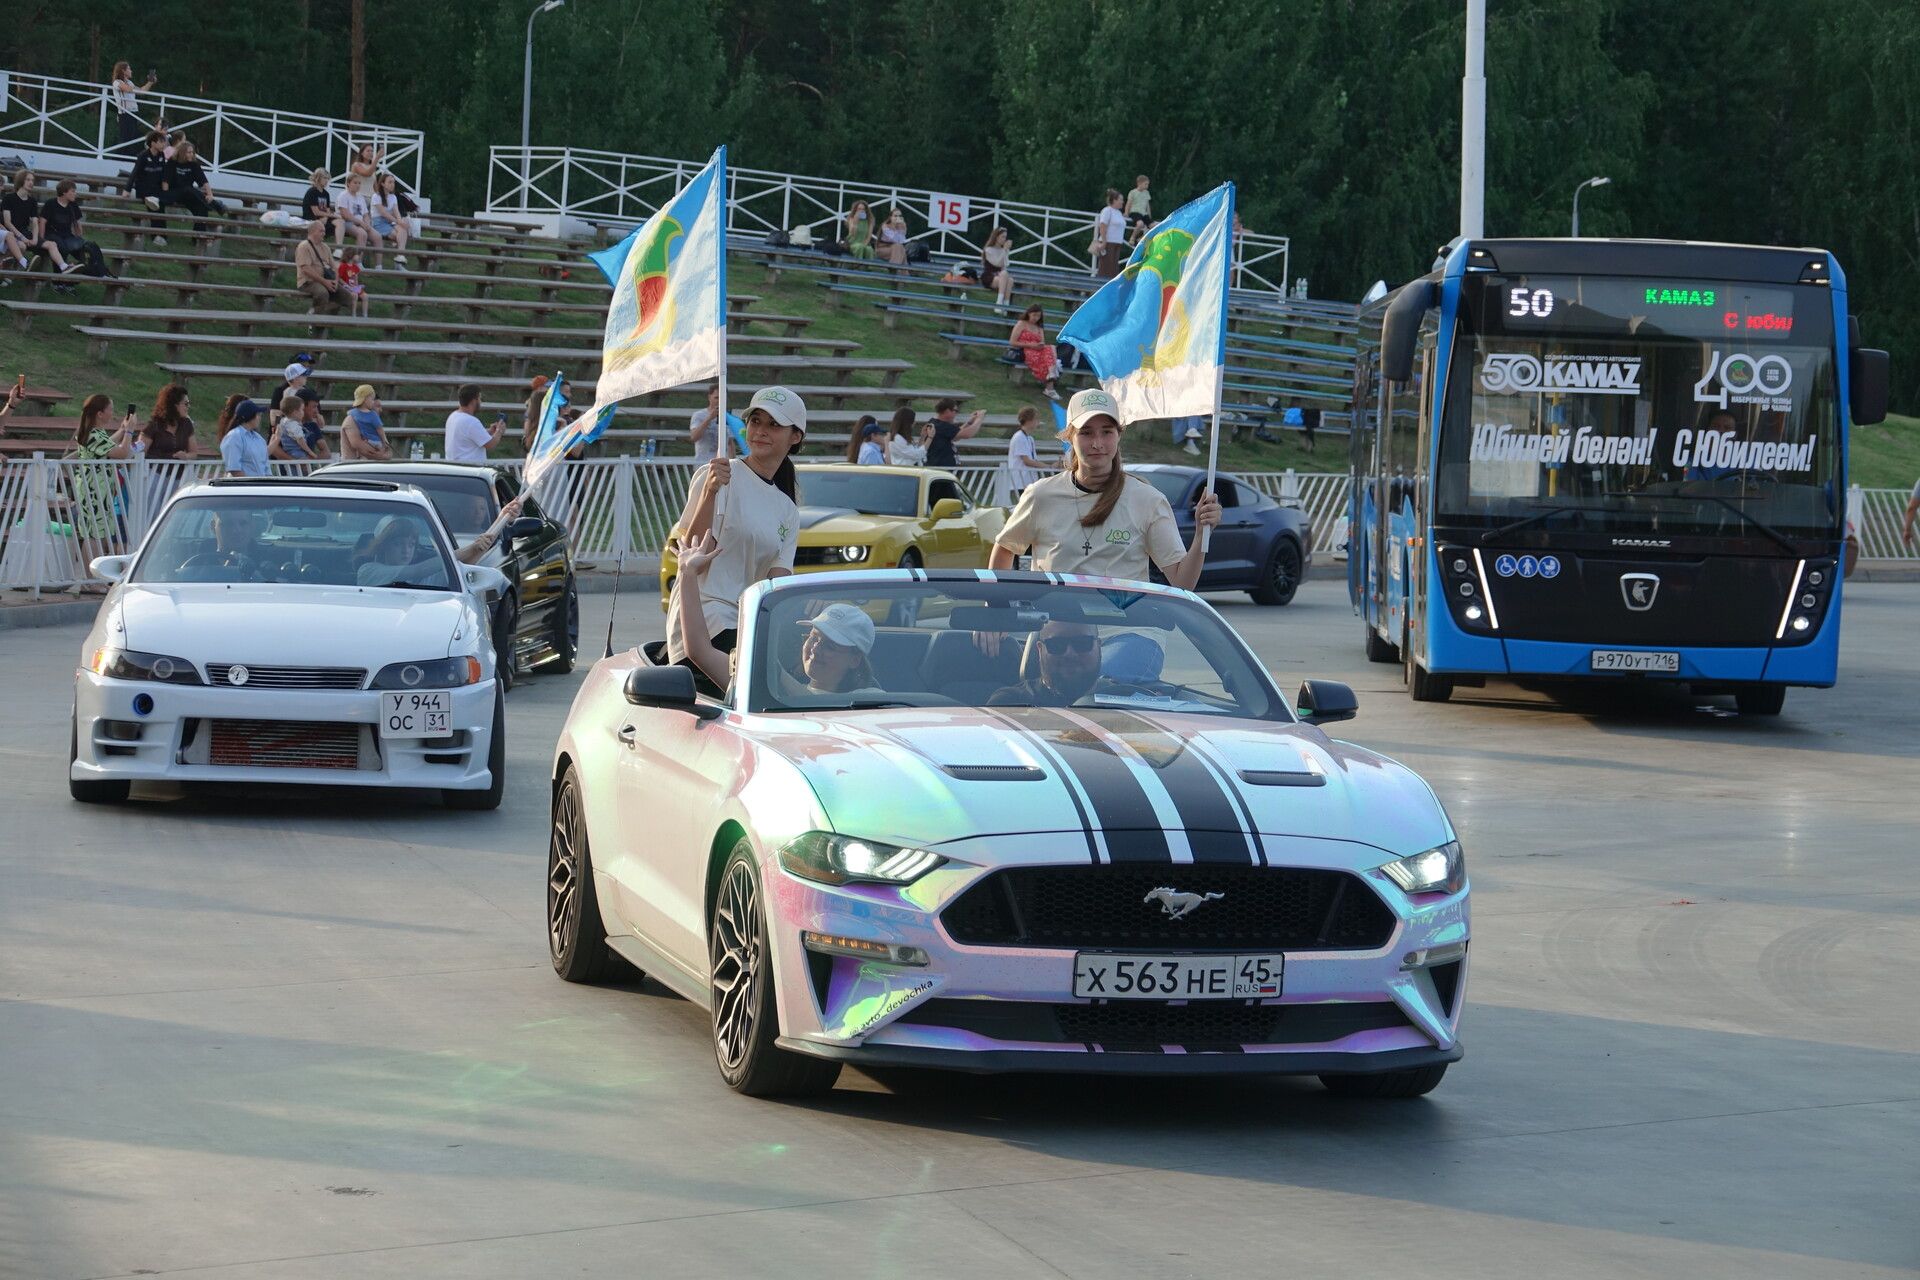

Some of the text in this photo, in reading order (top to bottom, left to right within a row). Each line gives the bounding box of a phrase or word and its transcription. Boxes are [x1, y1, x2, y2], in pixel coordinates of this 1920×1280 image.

[938, 200, 961, 225] 15
[1509, 288, 1554, 317] 50
[1645, 288, 1716, 306] КАМАЗ
[1480, 353, 1543, 391] 50
[1543, 361, 1641, 389] KAMAZ
[1694, 351, 1792, 410] 400
[1469, 424, 1572, 463] Юбилей
[1672, 429, 1816, 472] С Юбилеем!
[1611, 538, 1671, 547] KAMAZ
[411, 694, 440, 711] 944
[429, 714, 445, 726] 31
[1240, 959, 1270, 983] 45
[1235, 983, 1259, 993] RUS
